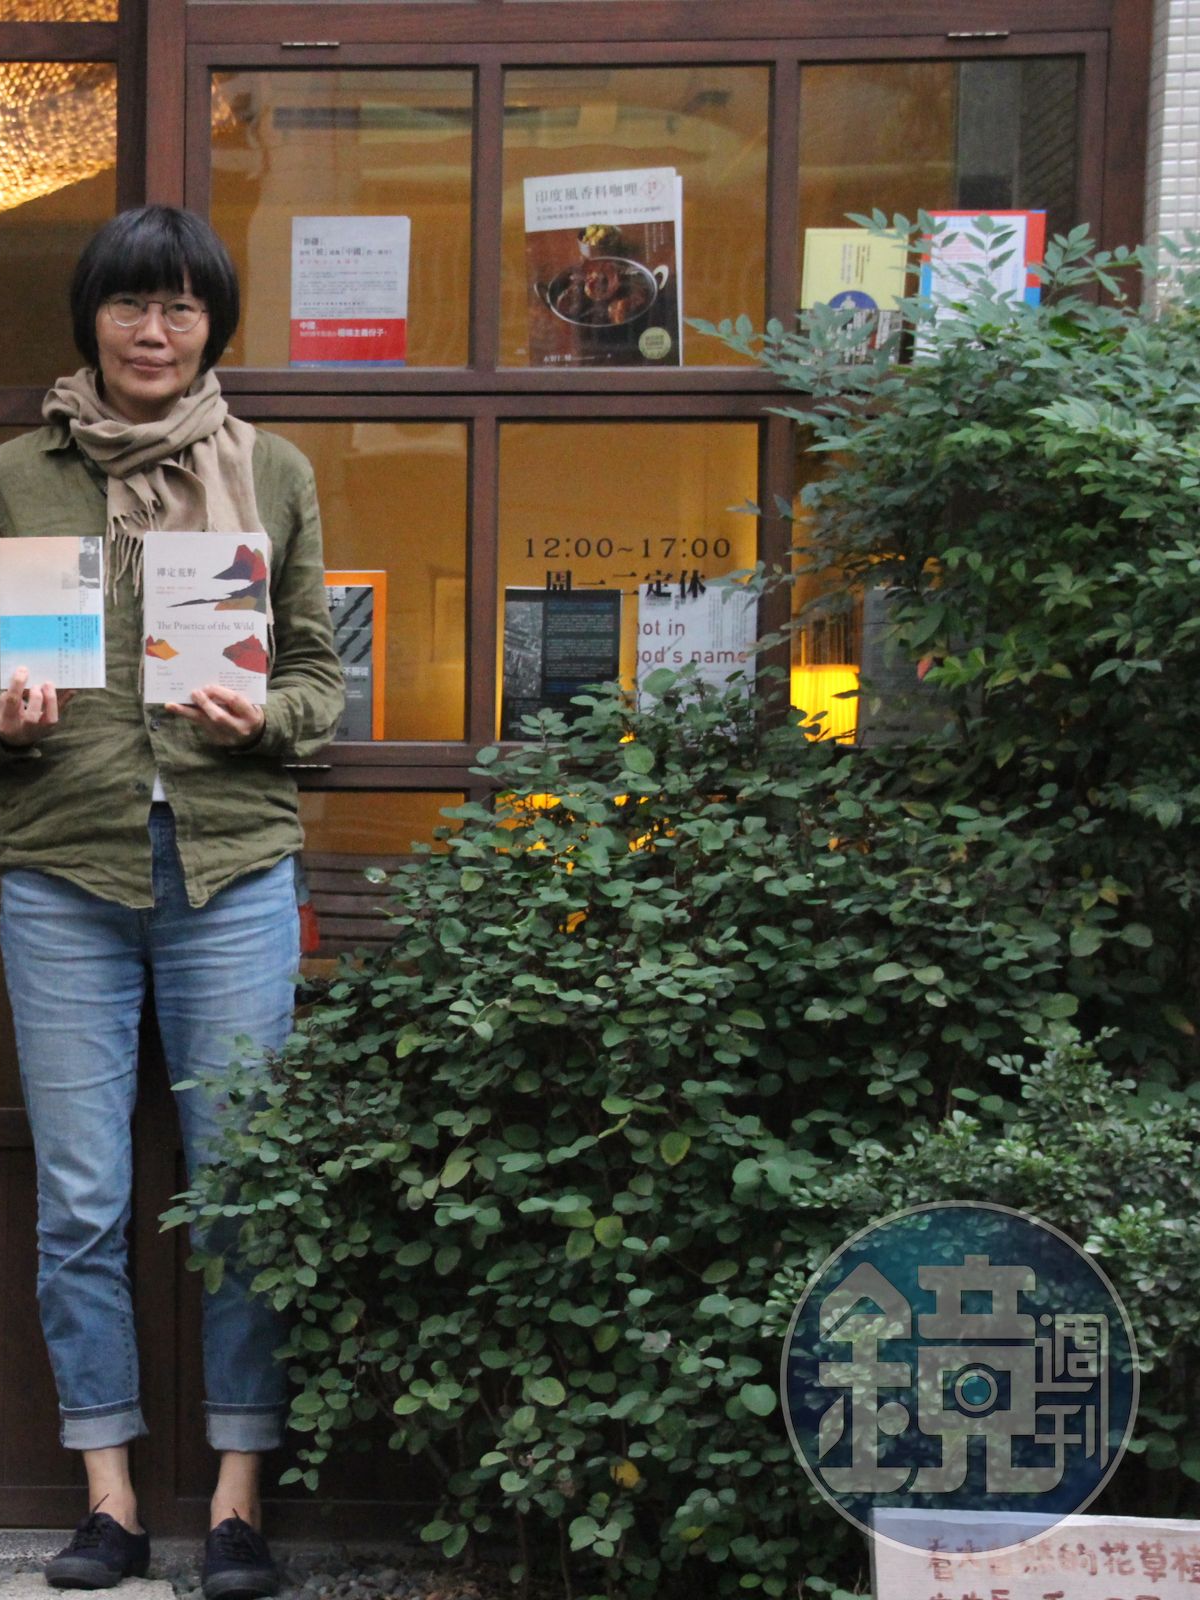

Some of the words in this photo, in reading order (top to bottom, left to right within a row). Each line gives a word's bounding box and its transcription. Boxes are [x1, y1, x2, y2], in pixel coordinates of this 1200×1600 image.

[525, 538, 731, 559] 12:00~17:00
[156, 621, 172, 631] The
[174, 621, 206, 631] Practice
[207, 621, 217, 631] of
[217, 621, 231, 631] the
[233, 621, 255, 631] Wild
[668, 619, 685, 636] in
[692, 650, 747, 664] name
